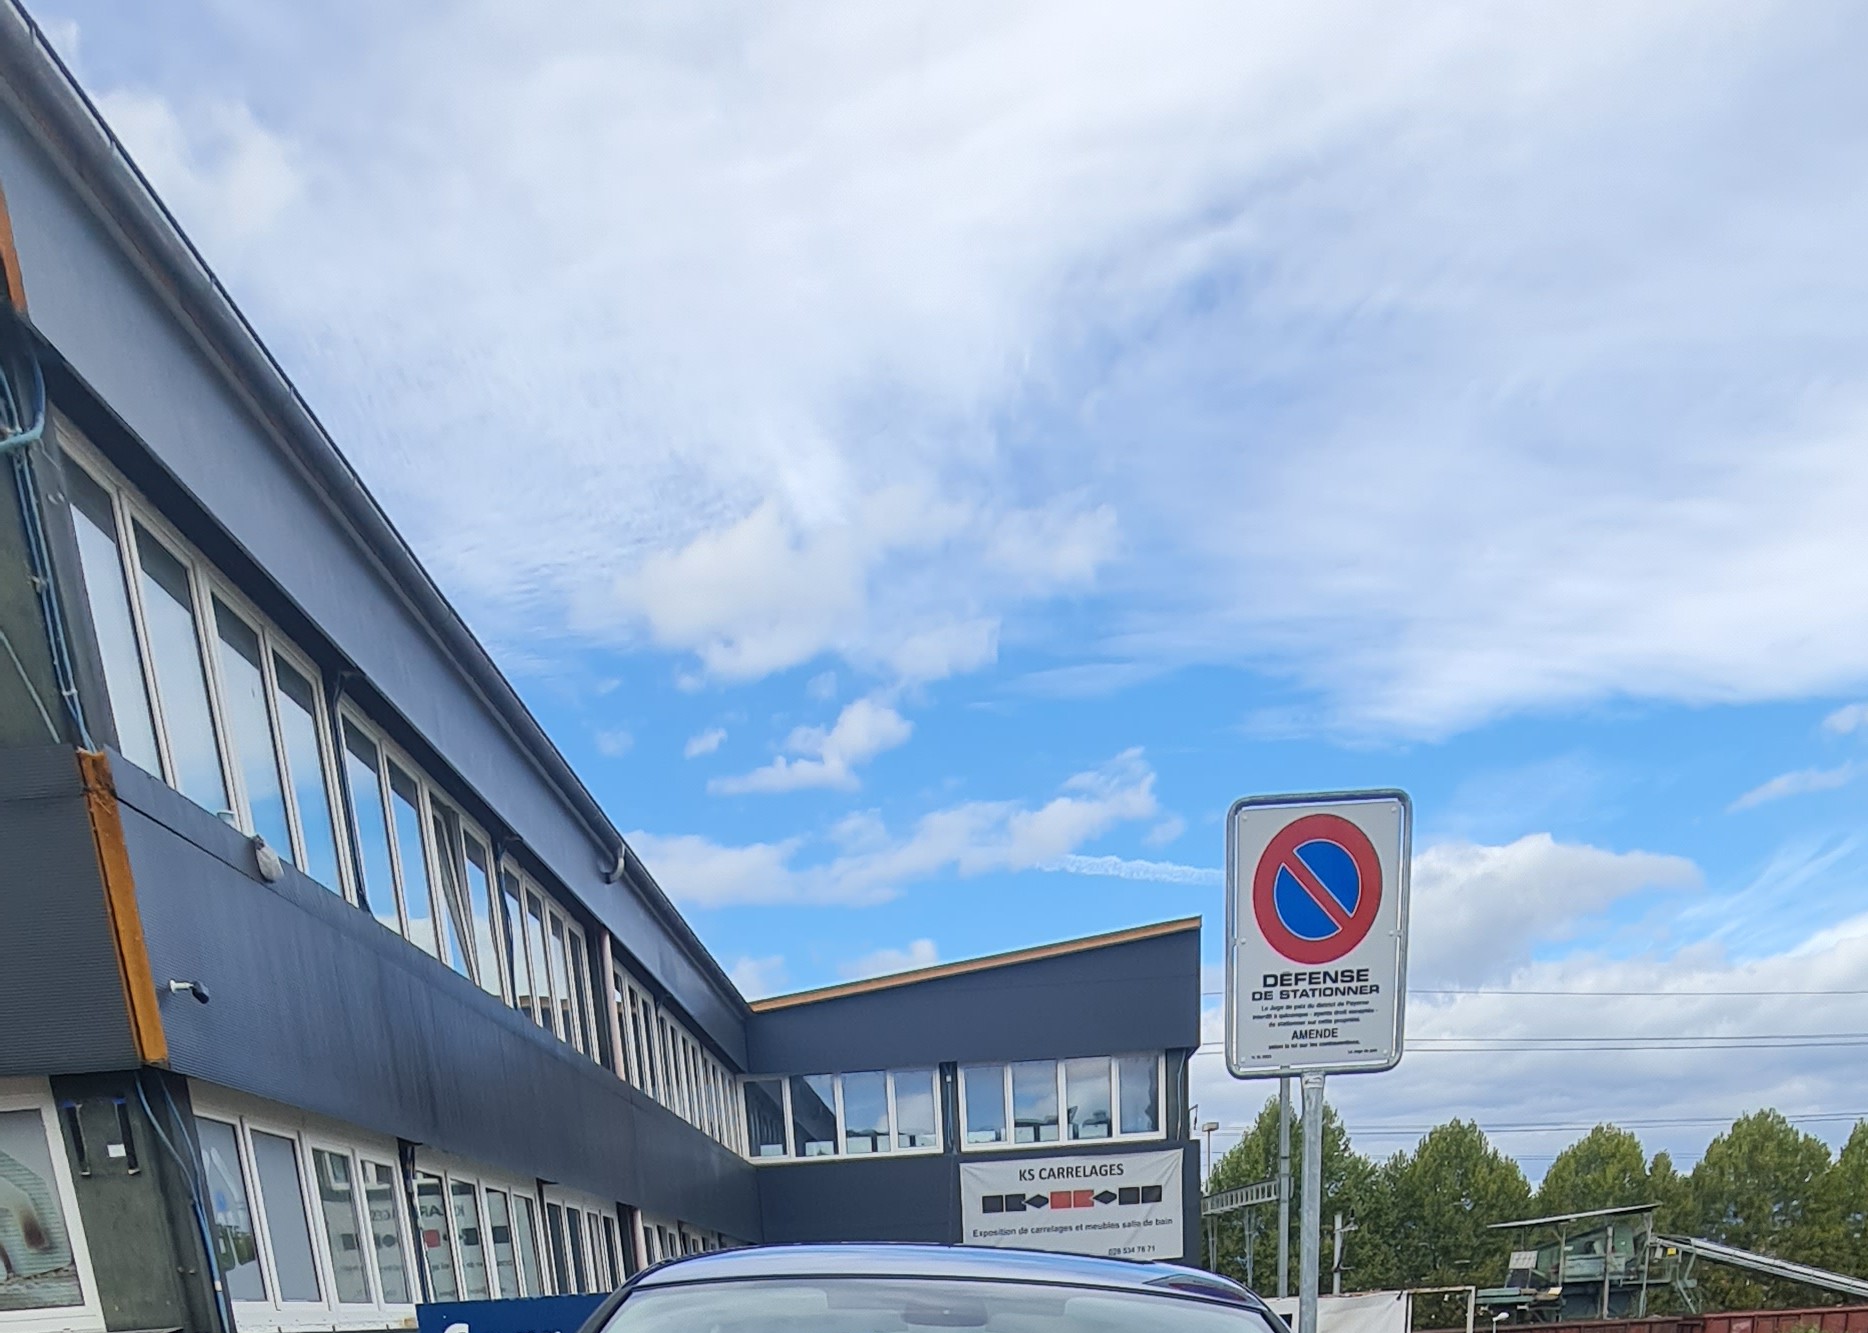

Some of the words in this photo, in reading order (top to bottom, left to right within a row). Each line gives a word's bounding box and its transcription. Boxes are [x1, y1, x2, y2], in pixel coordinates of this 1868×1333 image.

[1251, 990, 1274, 1001] DE
[1279, 984, 1380, 1000] STATIONNER
[1291, 1027, 1339, 1041] AMENDE
[1019, 1168, 1035, 1181] KS
[1038, 1163, 1124, 1181] CARRELAGES
[972, 1228, 1017, 1238] Exposition
[1018, 1226, 1028, 1235] de
